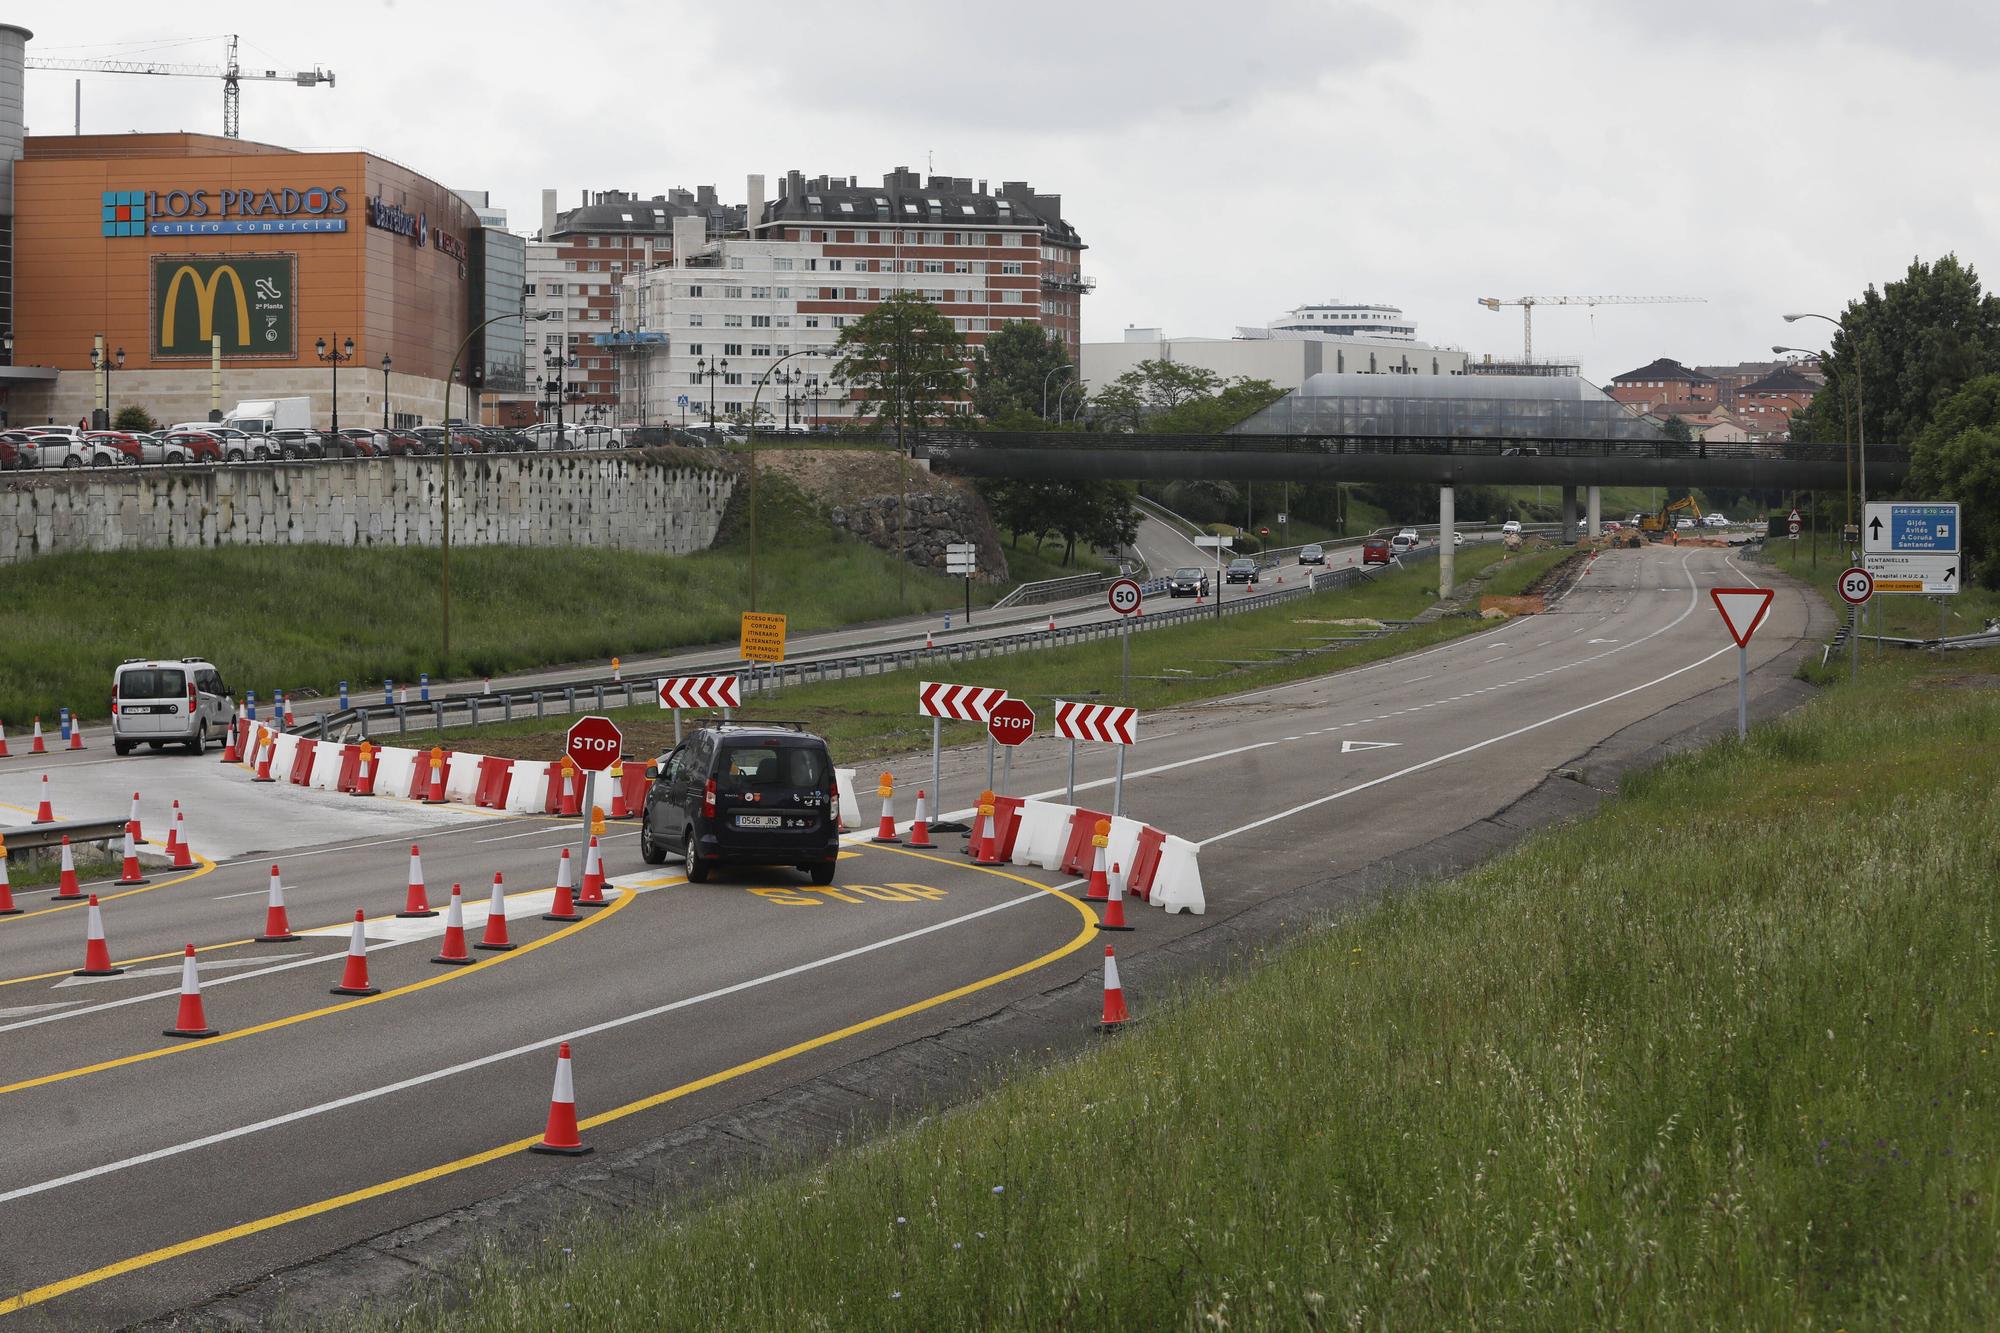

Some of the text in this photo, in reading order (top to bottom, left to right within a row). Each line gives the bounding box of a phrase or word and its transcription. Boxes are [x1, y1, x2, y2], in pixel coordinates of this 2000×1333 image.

[149, 186, 347, 217] LOS PRADOS
[151, 220, 343, 233] centro comercial
[1847, 580, 1867, 592] 50
[1116, 591, 1135, 603] 50
[993, 716, 1031, 729] STOP
[572, 736, 618, 753] STOP
[741, 816, 779, 825] 0546 JNS
[745, 882, 949, 906] STOP
